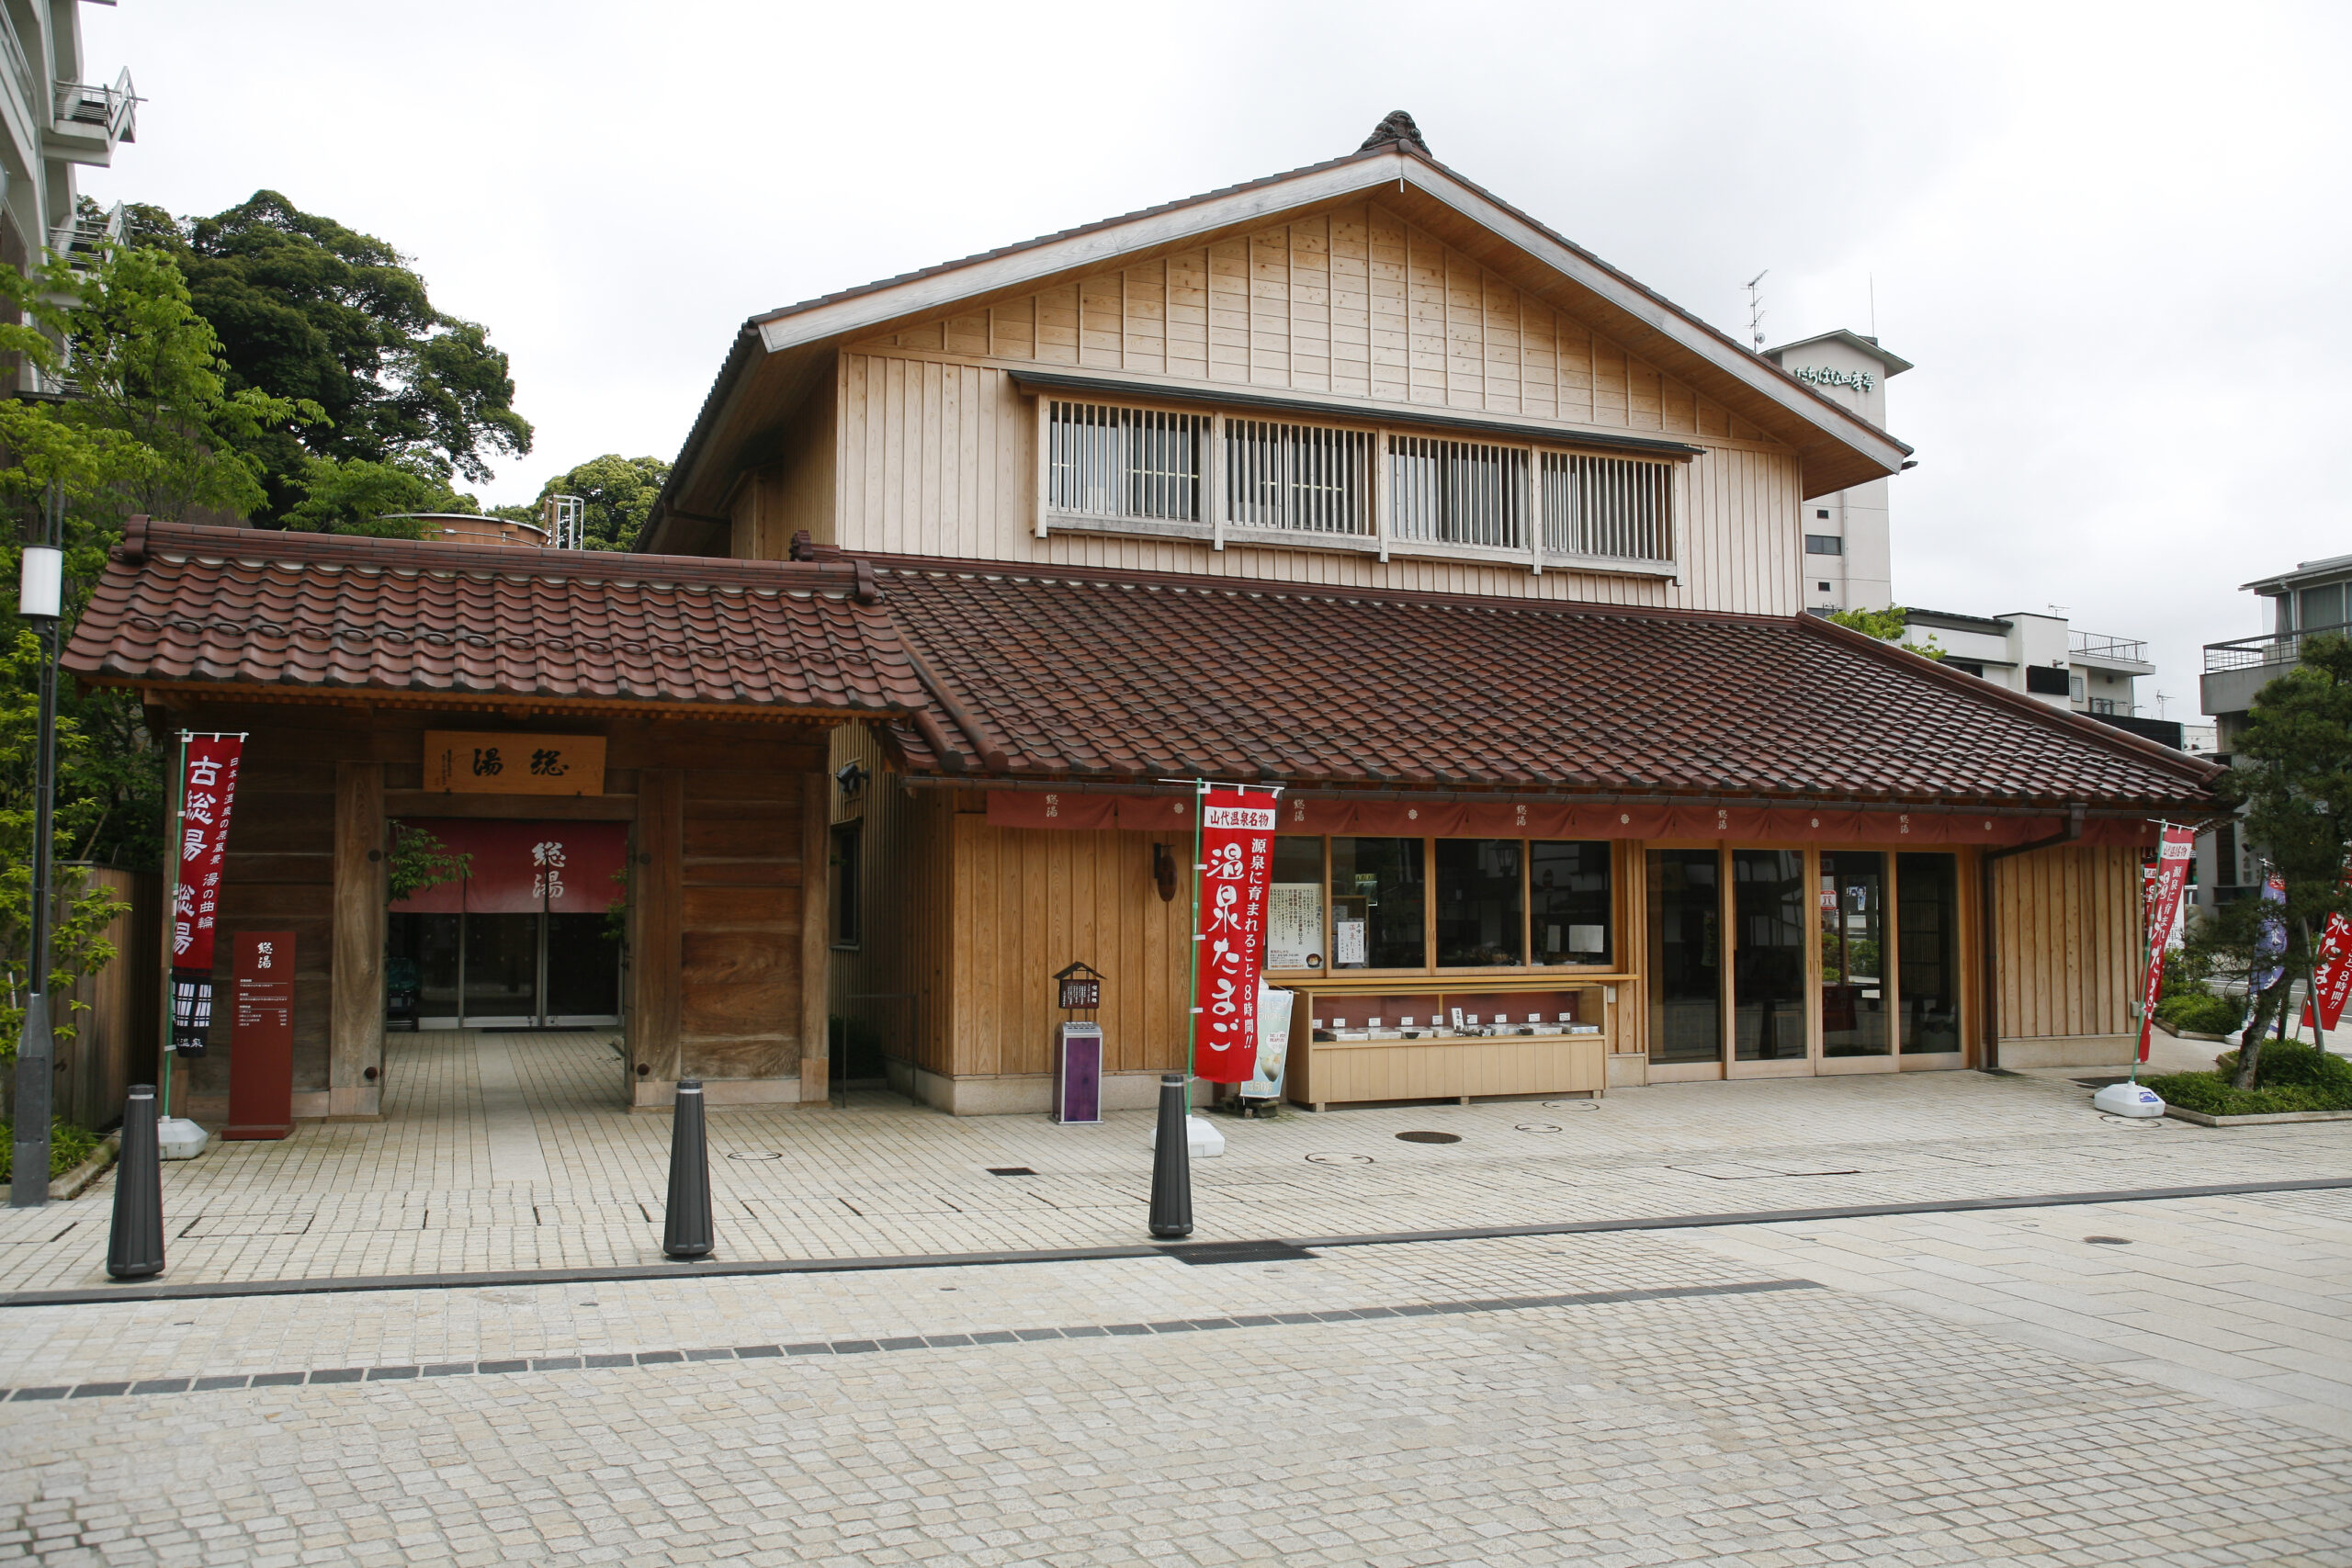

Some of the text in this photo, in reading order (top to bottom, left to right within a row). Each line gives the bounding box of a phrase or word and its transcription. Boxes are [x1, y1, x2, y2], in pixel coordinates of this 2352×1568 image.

[1795, 366, 1875, 392] たちばな四季亭
[184, 755, 223, 862] 古総湯
[1210, 809, 1269, 827] 山代温泉名物
[197, 757, 238, 930] 日本の温泉の原風景 湯の曲輪
[1206, 842, 1245, 1052] 温泉たまご
[176, 1038, 204, 1048] 温泉
